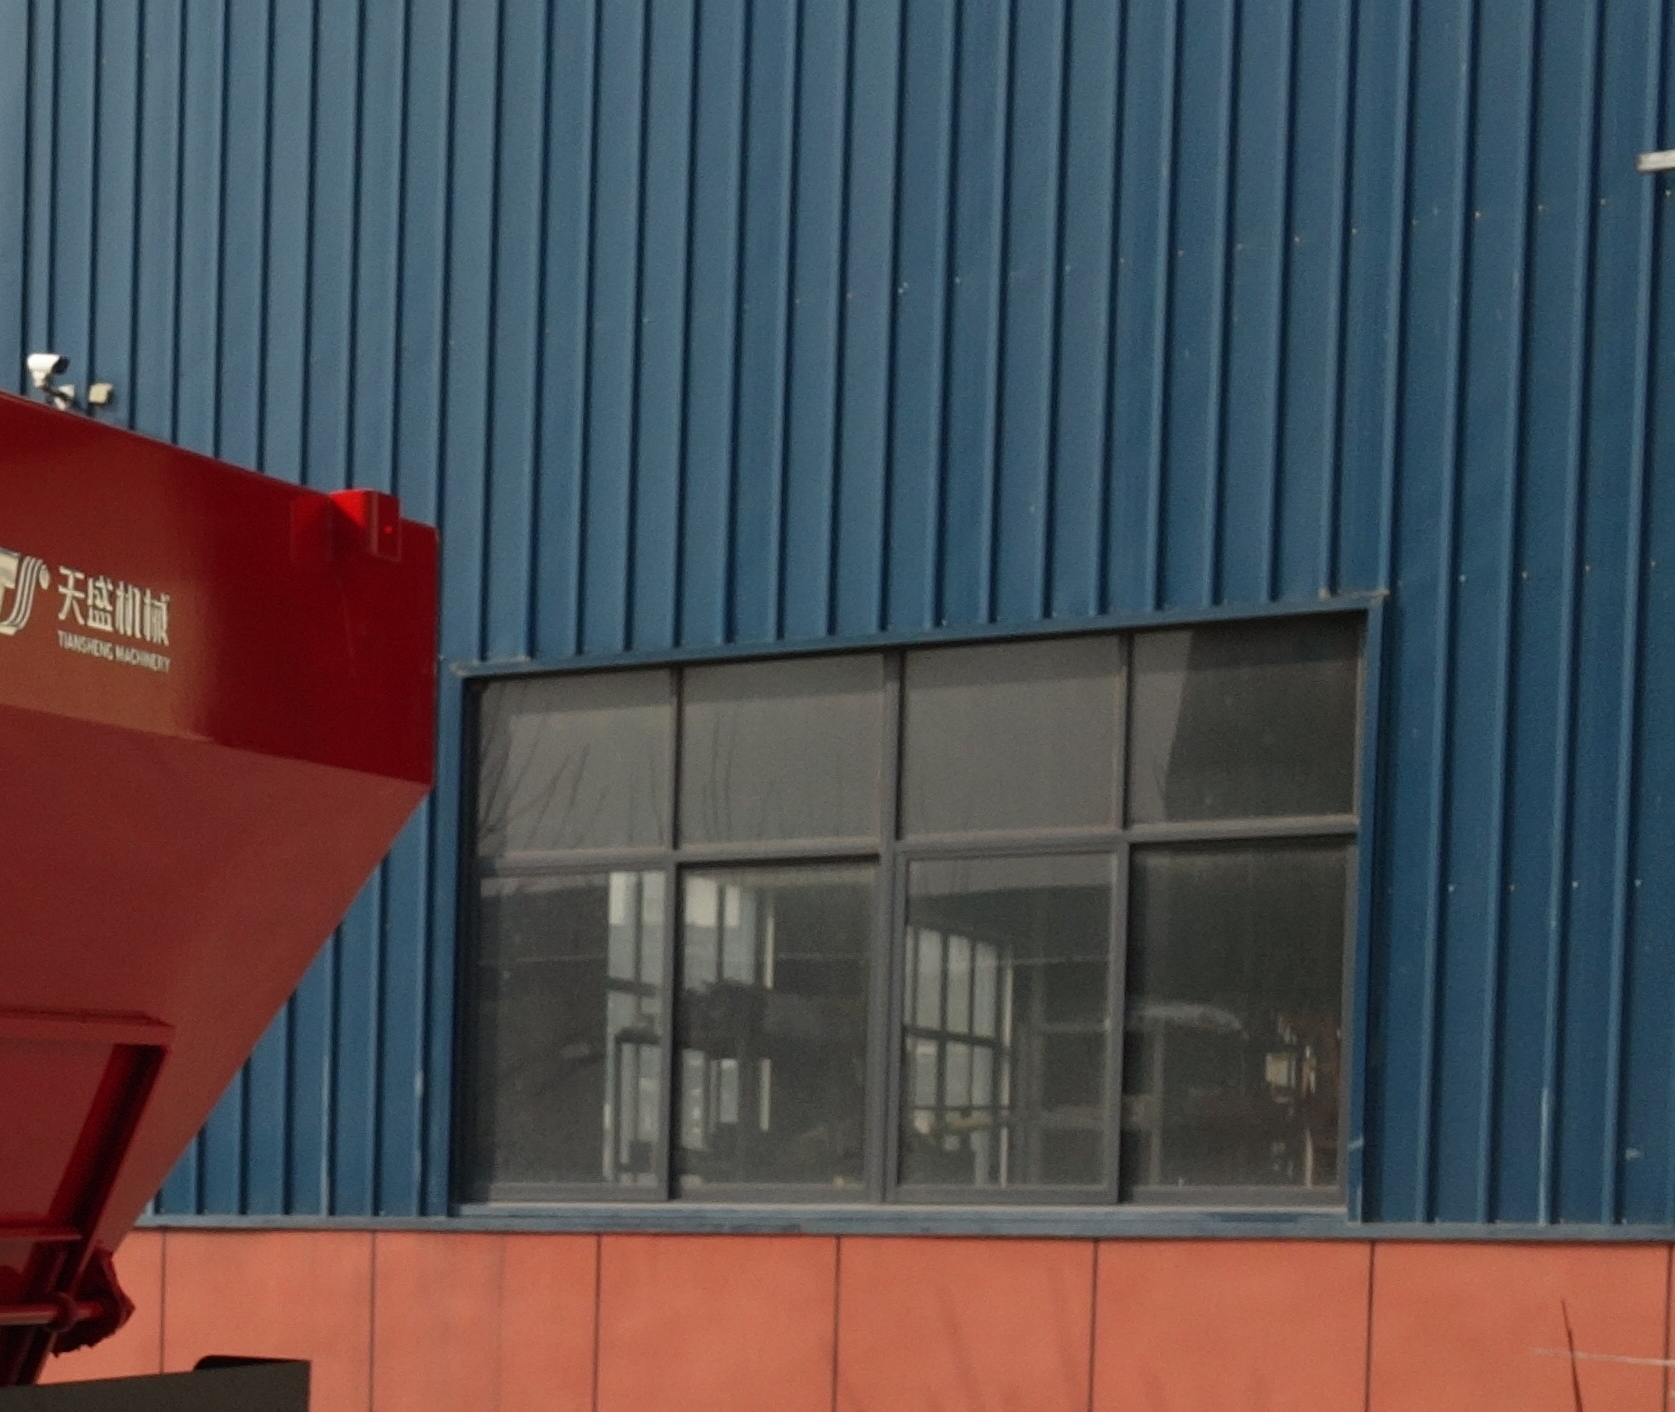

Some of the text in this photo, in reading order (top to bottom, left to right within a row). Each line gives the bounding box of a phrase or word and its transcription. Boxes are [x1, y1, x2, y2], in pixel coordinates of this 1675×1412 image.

[57, 565, 171, 646] 天盛机械
[57, 630, 171, 673] TIANSHENG MACHINERY
